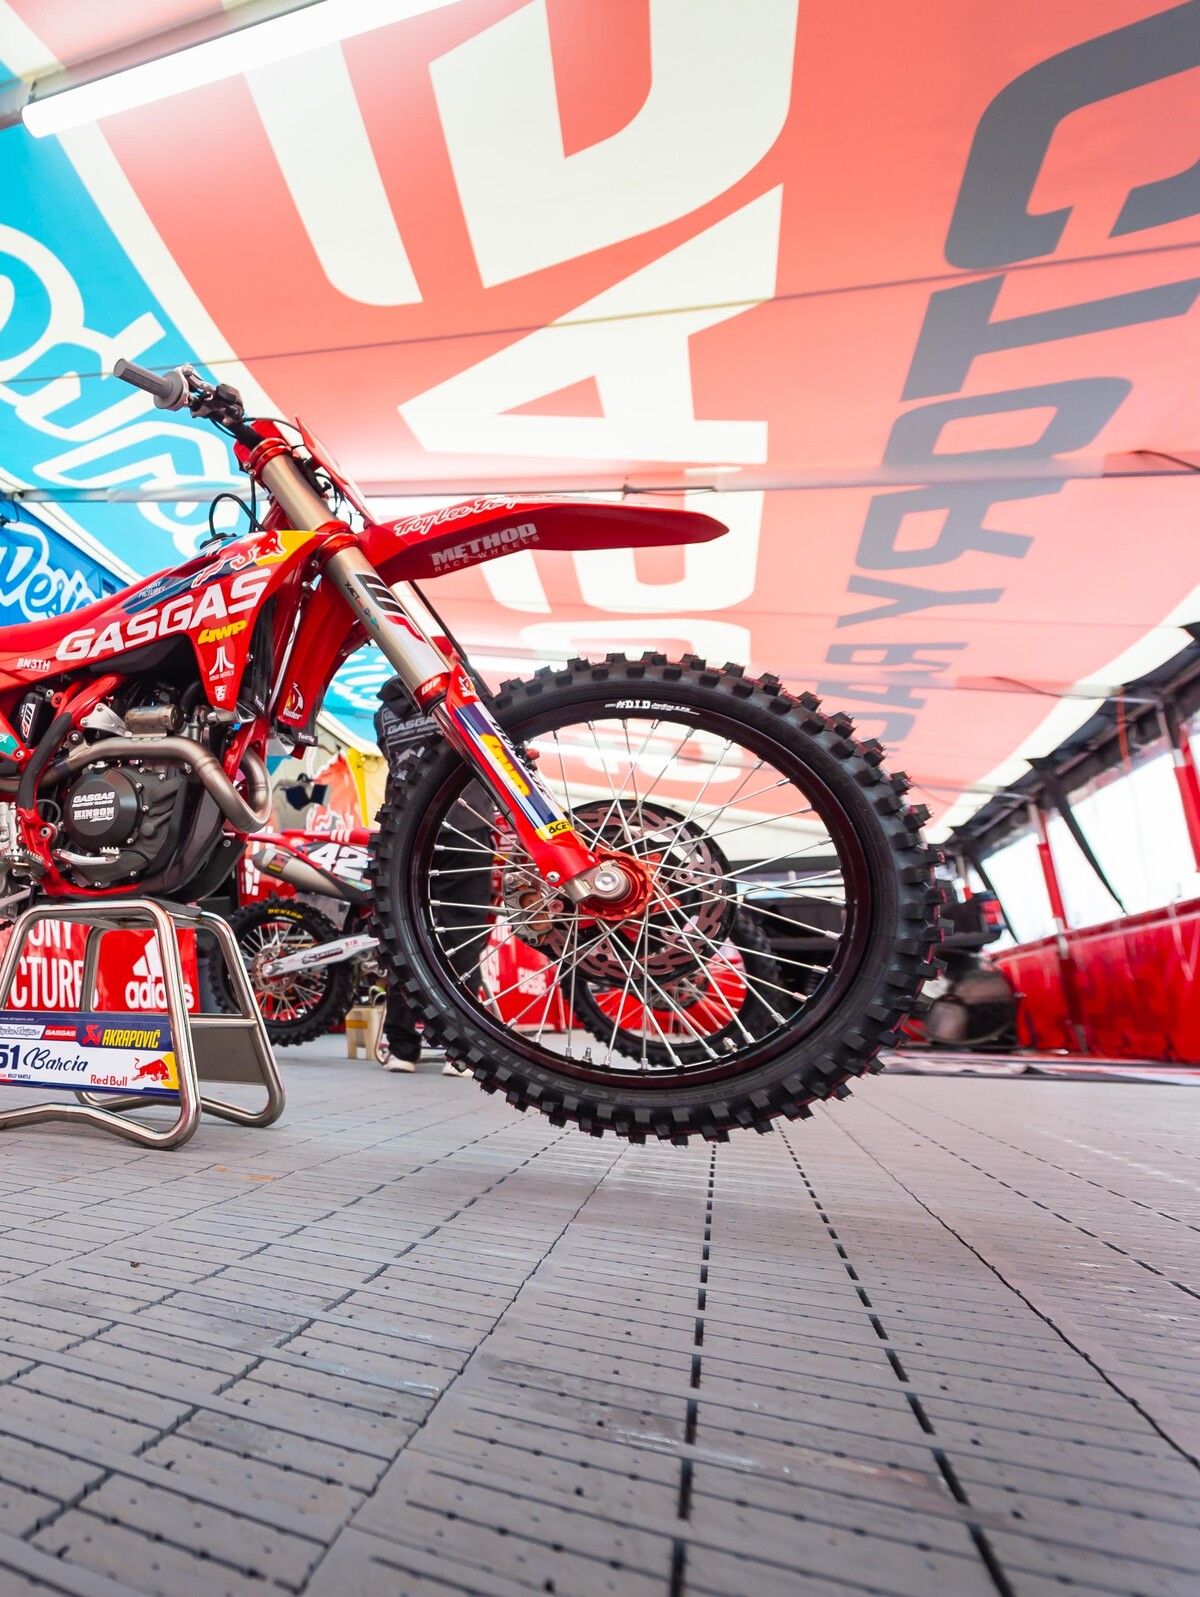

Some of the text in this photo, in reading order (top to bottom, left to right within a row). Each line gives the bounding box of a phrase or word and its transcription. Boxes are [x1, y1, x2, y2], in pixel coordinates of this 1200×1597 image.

[393, 514, 435, 537] Troy
[434, 505, 474, 526] Lee
[430, 523, 538, 567] METHOD
[434, 534, 541, 573] RACE WHEELS
[55, 568, 272, 661] GASGAS
[197, 619, 248, 645] 4WP
[16, 657, 51, 671] BN3TH
[73, 791, 116, 804] GASGAS
[307, 842, 369, 881] 42
[267, 908, 303, 920] DUNLOP
[45, 1029, 77, 1037] GASGAS
[22, 1046, 89, 1073] Barcia
[90, 1074, 128, 1087] Red Bull
